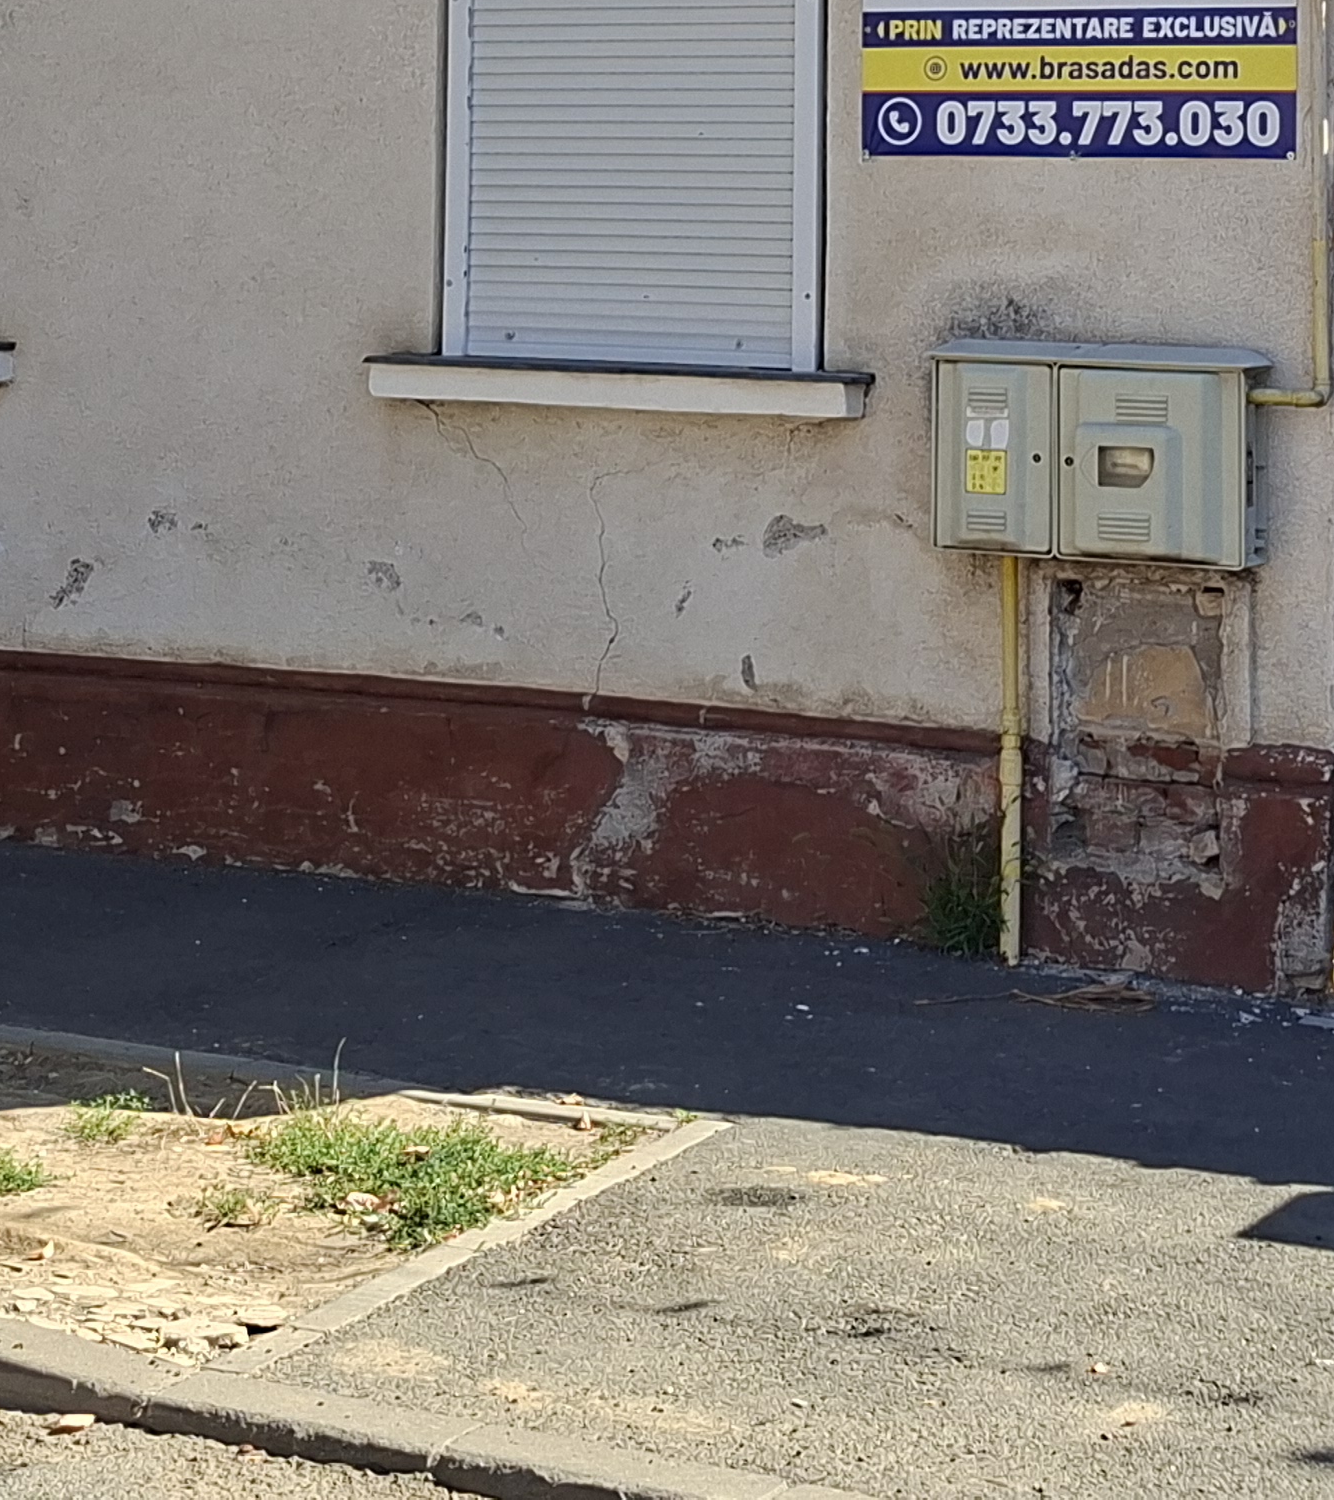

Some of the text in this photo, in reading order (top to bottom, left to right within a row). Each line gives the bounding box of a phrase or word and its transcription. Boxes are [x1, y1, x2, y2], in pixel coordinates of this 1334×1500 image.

[889, 12, 1277, 40] PRIN REPREZENTARE EXCLUSIVĂ
[960, 56, 1239, 80] www.brasadas.com
[936, 100, 1280, 146] 0733.773.030
